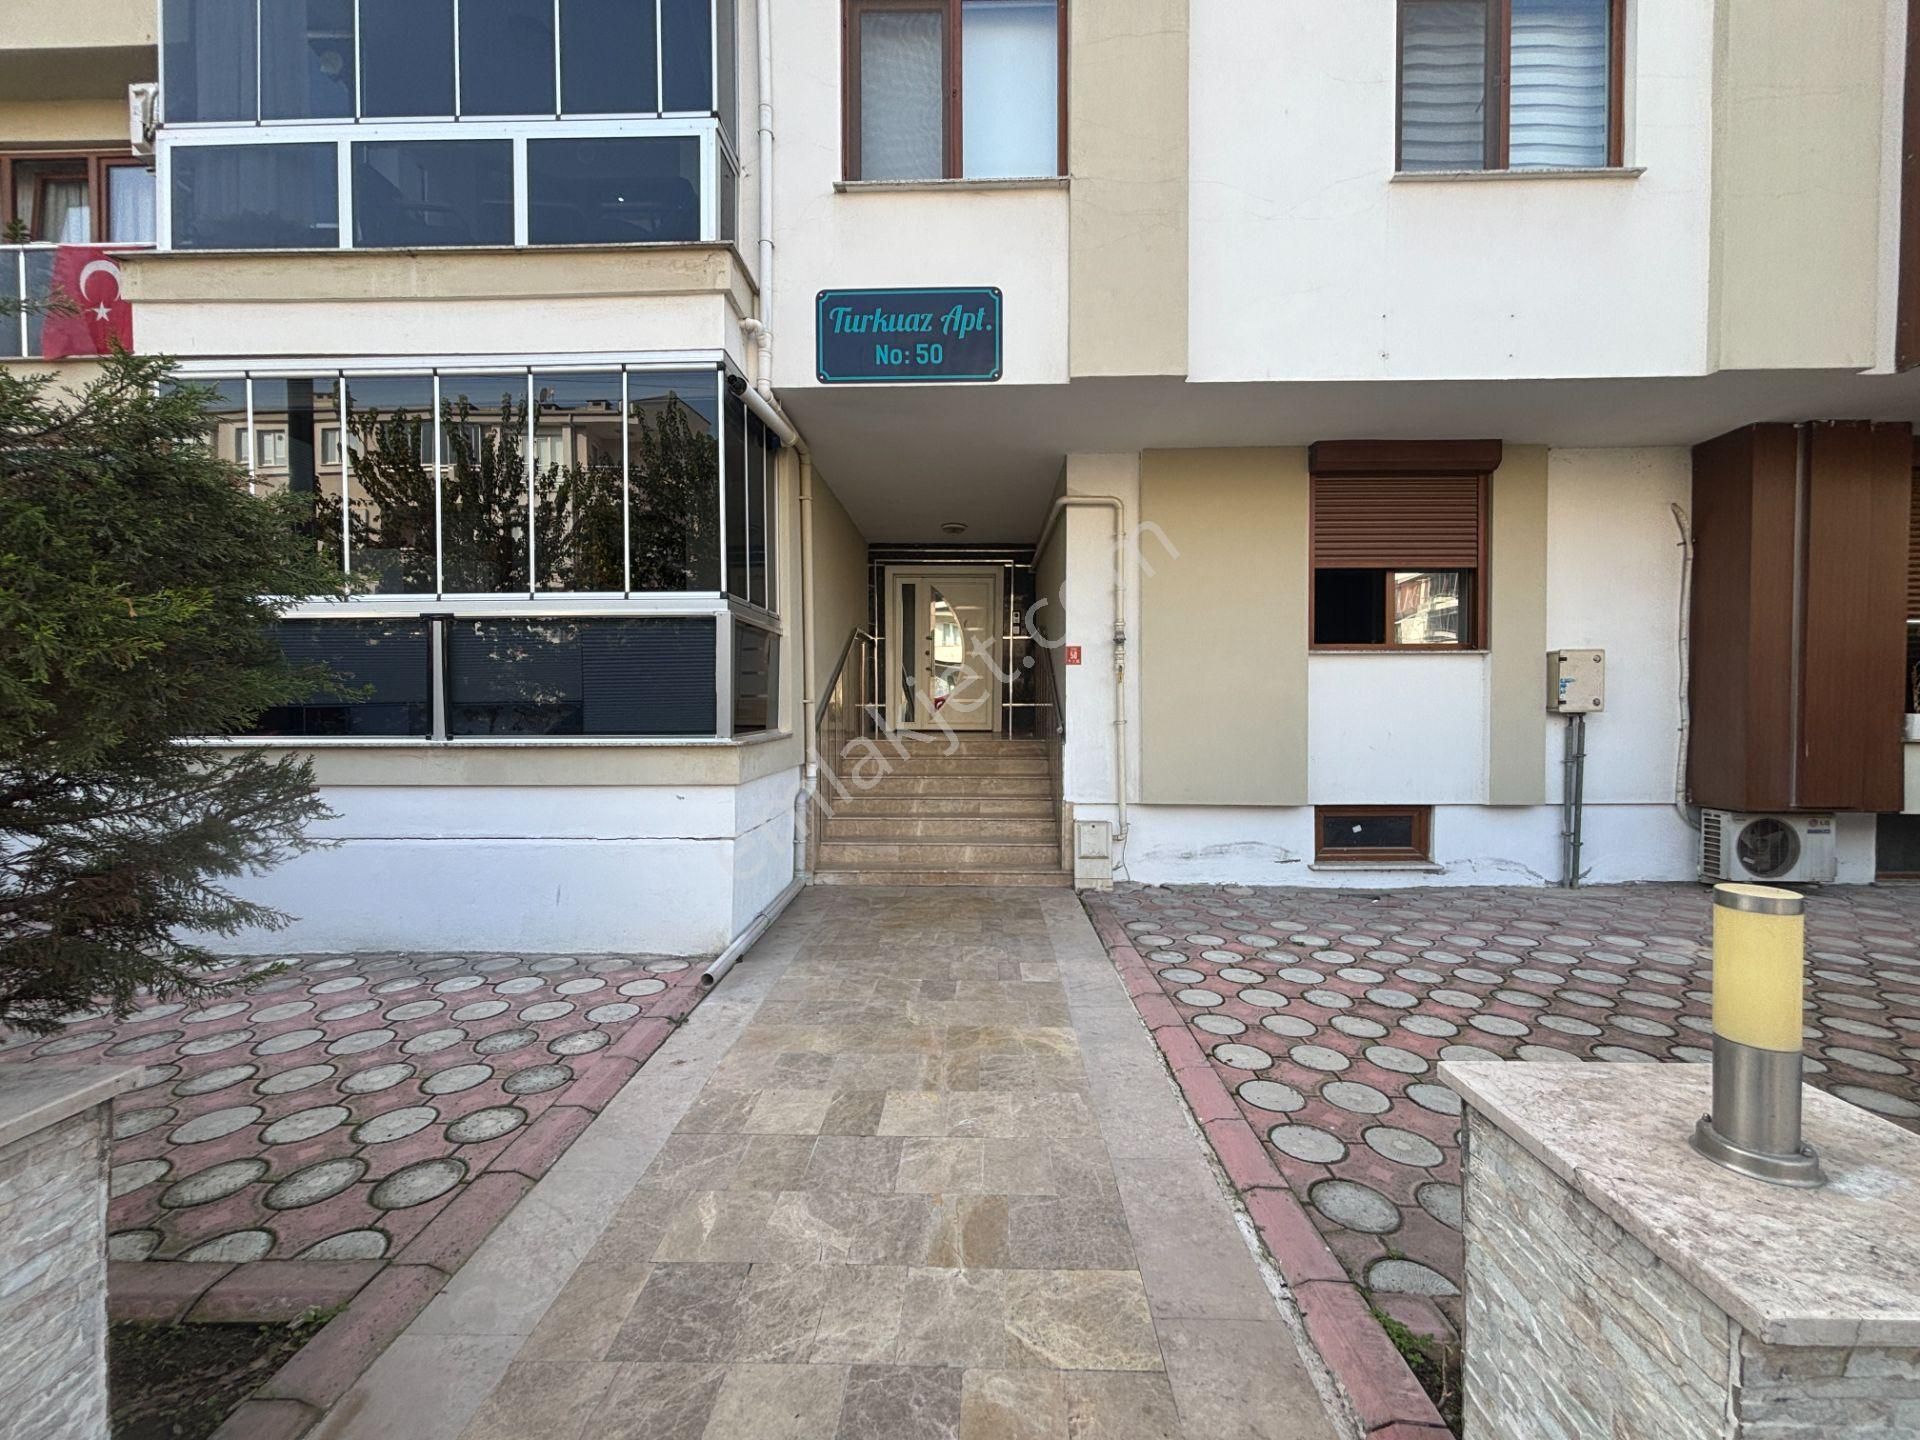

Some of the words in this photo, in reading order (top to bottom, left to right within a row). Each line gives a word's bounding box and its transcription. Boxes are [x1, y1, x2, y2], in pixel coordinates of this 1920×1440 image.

[829, 306, 934, 334] Turkuaz
[940, 304, 993, 340] Apt.
[875, 344, 910, 365] No:
[915, 343, 944, 364] 50
